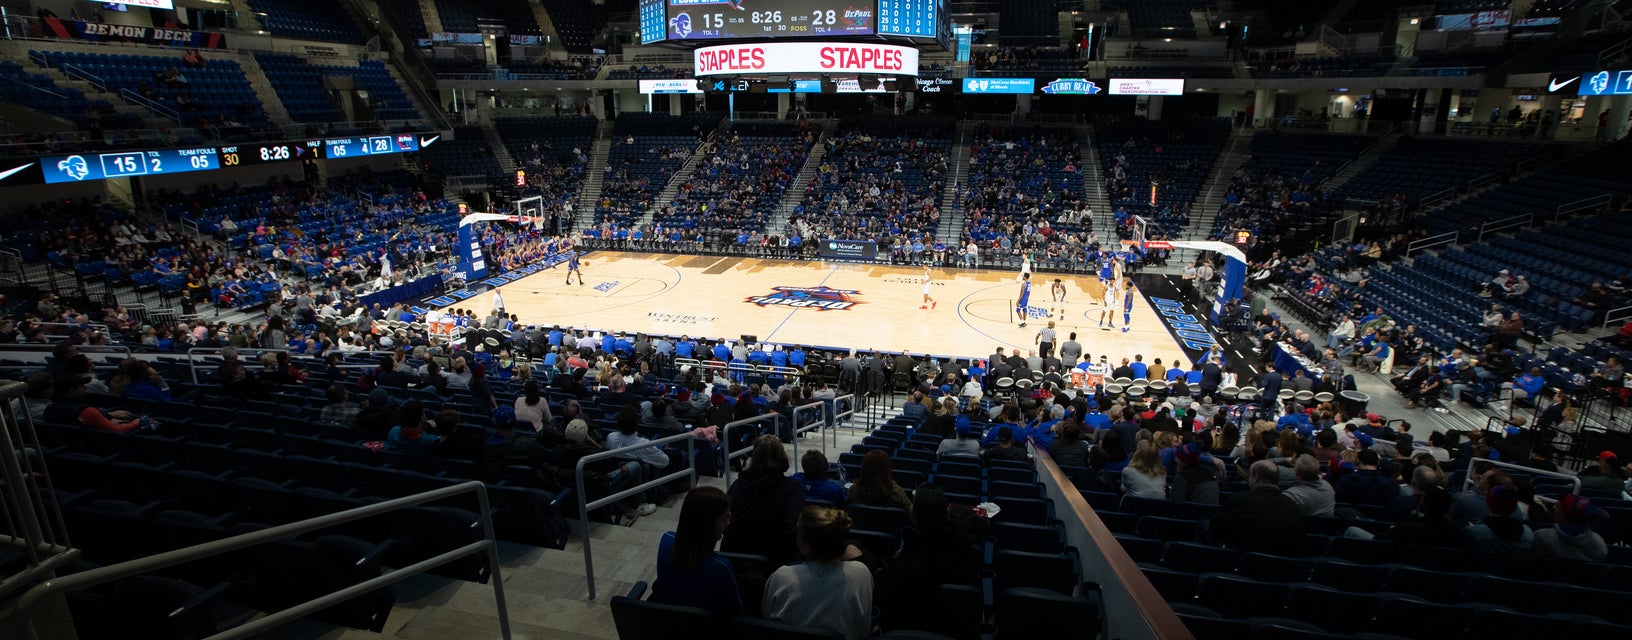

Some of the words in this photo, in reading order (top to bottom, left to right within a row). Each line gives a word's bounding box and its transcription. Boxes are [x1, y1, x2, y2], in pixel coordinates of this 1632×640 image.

[703, 14, 724, 28] 15
[752, 10, 782, 24] 8:26
[812, 10, 836, 25] 28
[85, 23, 146, 38] DEMON
[154, 29, 193, 42] DECK
[700, 48, 765, 72] STAPLES
[820, 47, 902, 70] STAPLES
[1052, 82, 1072, 91] CUBBY
[1074, 82, 1091, 92] BEAR
[334, 145, 346, 156] 05
[362, 144, 368, 153] 4
[375, 140, 387, 150] 28
[224, 154, 239, 165] 30
[260, 146, 290, 160] 8:26
[313, 148, 317, 158] 1
[114, 157, 137, 172] 15
[151, 159, 162, 171] 2
[190, 156, 209, 168] 05
[1149, 296, 1224, 351] DEPAUL
